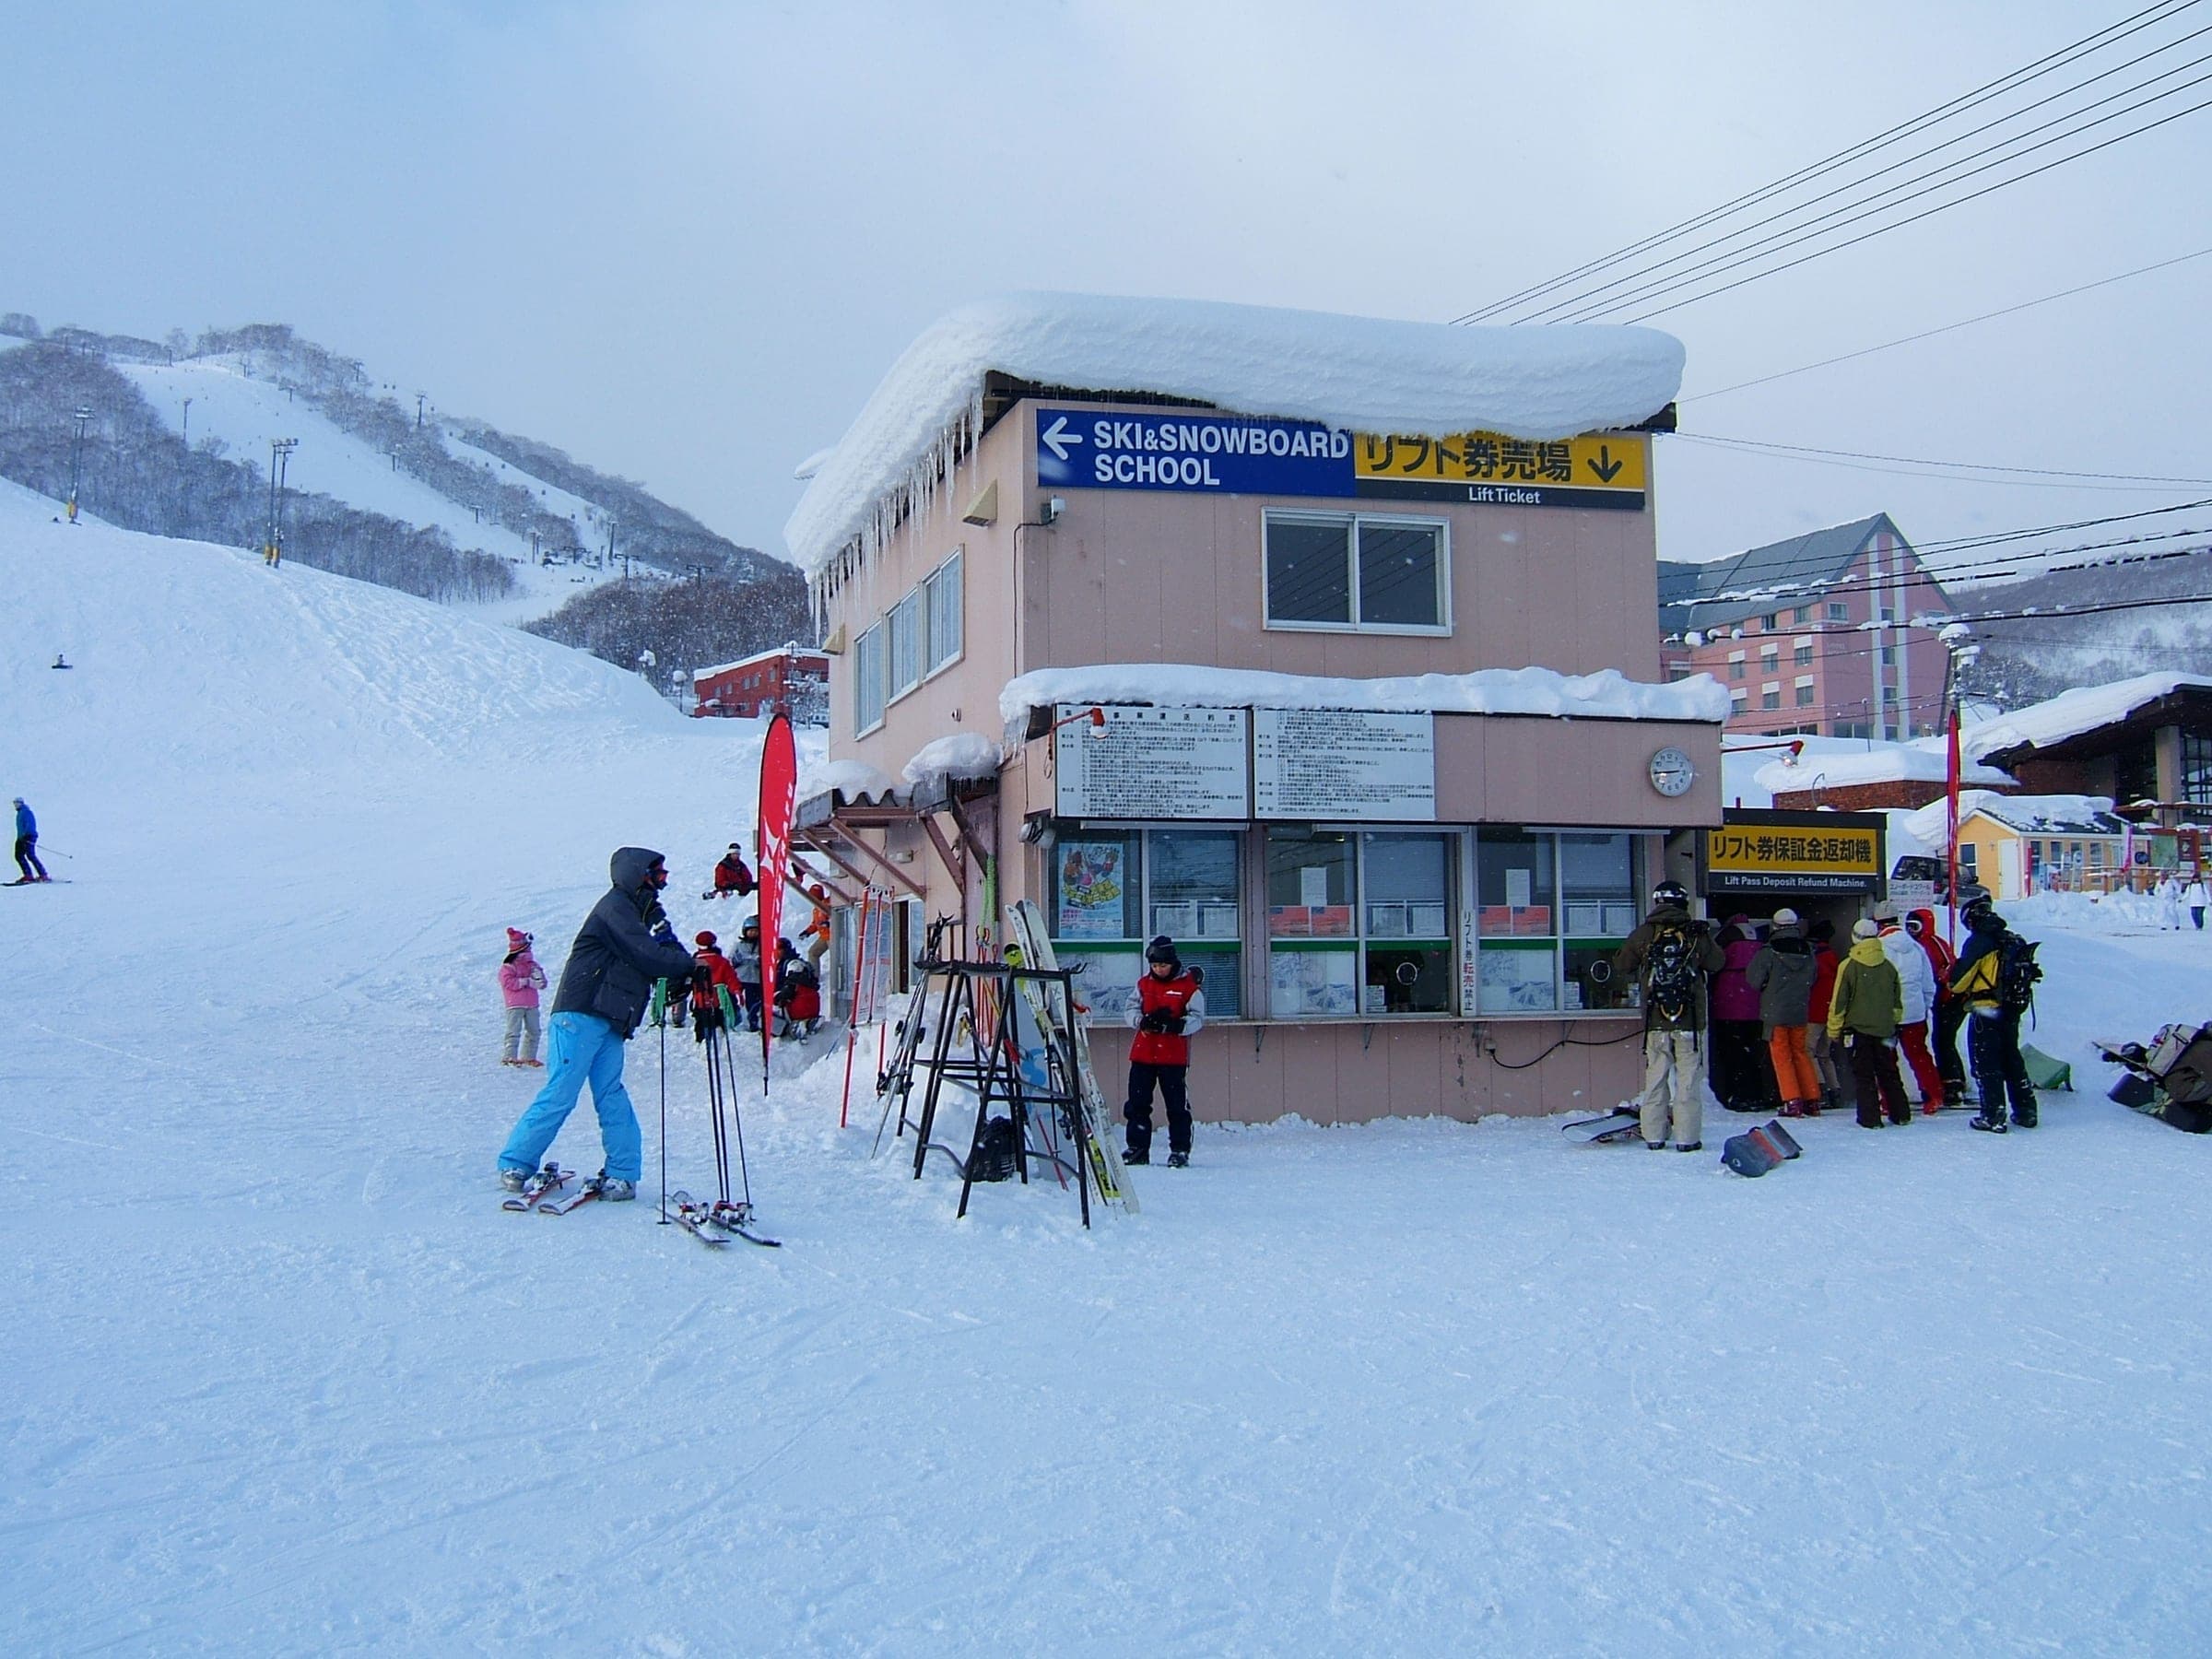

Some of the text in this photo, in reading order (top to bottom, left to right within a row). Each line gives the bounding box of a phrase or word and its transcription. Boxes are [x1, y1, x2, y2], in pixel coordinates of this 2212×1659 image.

[1094, 420, 1348, 459] SKI&SNOWBOARD
[1095, 453, 1220, 486] SCHOOL
[1366, 434, 1571, 482] リフト券売場
[1468, 487, 1541, 504] Lift Ticket
[1714, 836, 1872, 864] リフト券保証金返却機
[1724, 876, 1867, 888] Lift Pass Deposit Refund Machine.
